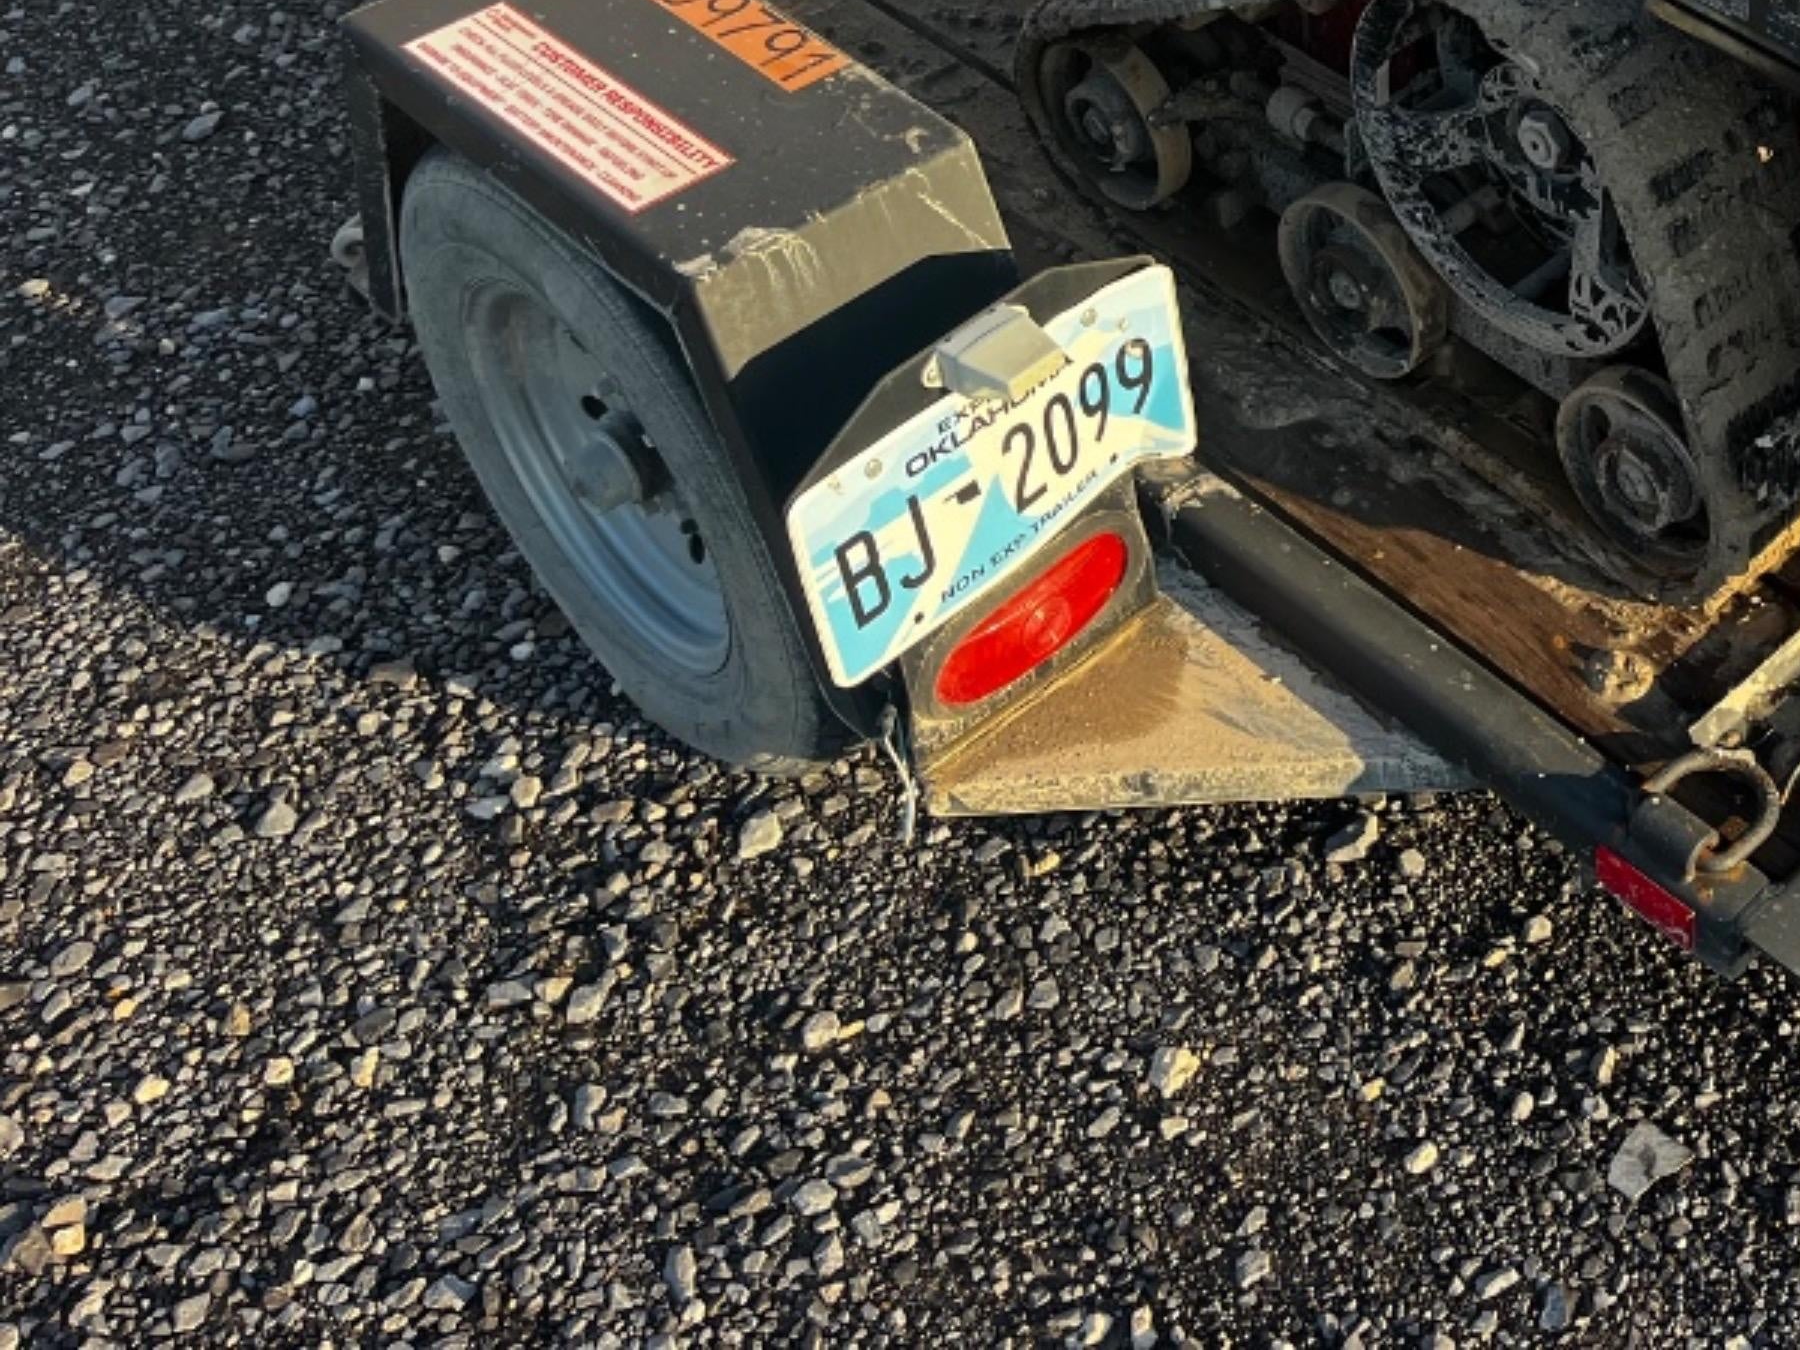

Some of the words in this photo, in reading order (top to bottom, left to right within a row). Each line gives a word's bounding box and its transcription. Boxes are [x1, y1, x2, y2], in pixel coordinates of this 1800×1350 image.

[532, 41, 608, 94] CUSTOMER
[603, 89, 719, 169] RESPONSIBILITY
[940, 564, 987, 604] NON
[989, 532, 1027, 571] EXP
[1029, 469, 1099, 533] TRAILER
